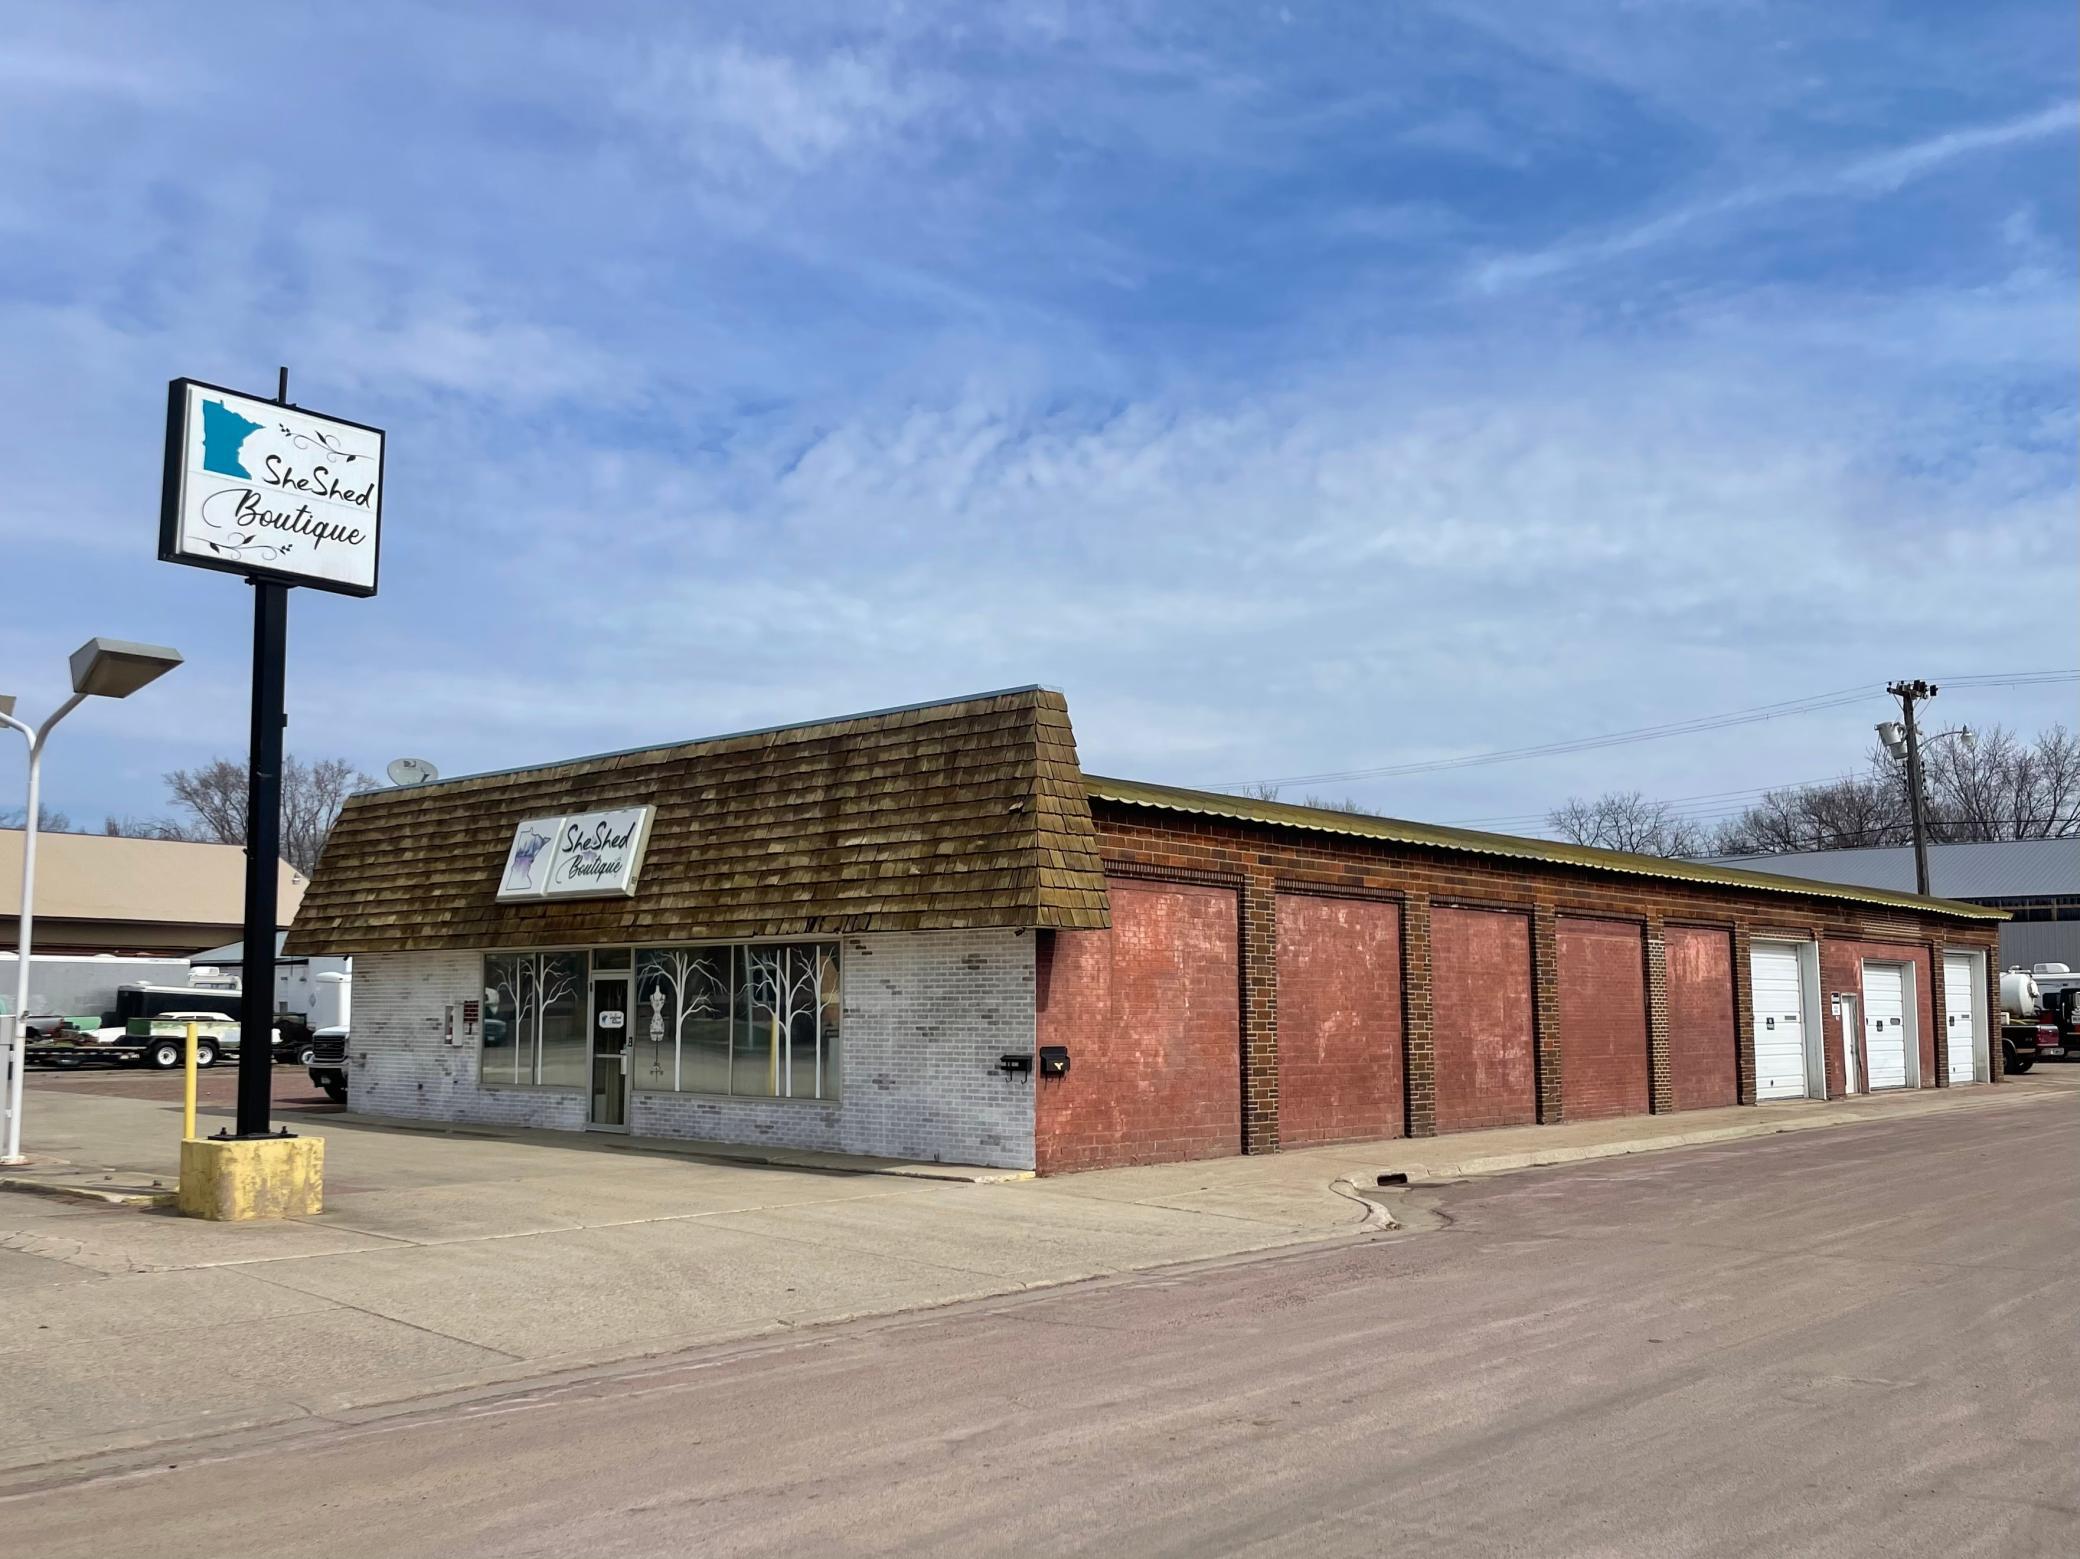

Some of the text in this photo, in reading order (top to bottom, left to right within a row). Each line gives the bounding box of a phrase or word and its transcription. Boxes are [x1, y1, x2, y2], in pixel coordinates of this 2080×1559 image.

[262, 454, 375, 509] SheShed
[202, 488, 366, 550] Boutique
[555, 854, 623, 884] Boutique
